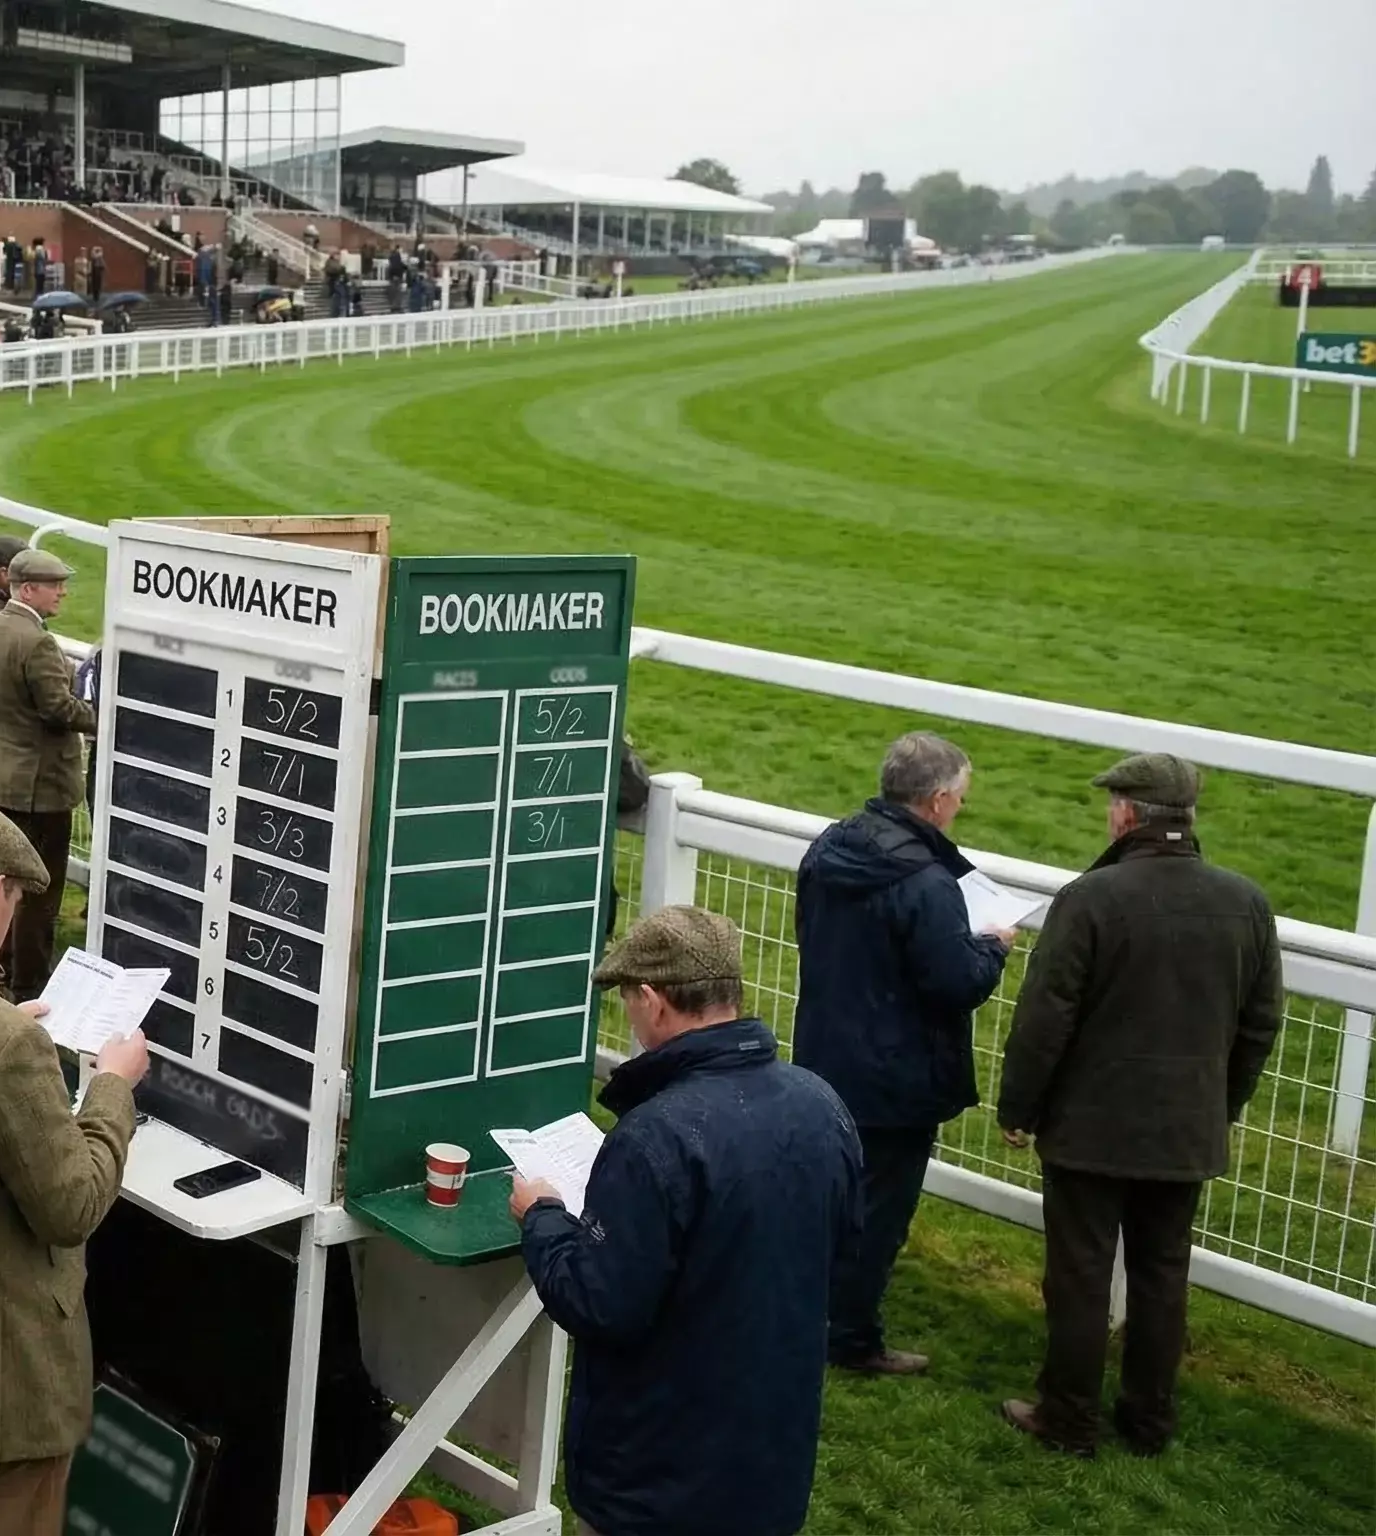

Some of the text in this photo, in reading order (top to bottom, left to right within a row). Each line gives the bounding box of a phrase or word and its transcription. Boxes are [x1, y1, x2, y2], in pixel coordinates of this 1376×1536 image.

[133, 560, 337, 628] BOOKMAKER
[419, 591, 605, 635] BOOKMAKER
[226, 688, 233, 708] 1
[265, 688, 319, 738] 5/2
[534, 697, 585, 740] 5/2
[221, 749, 231, 768] 2
[263, 750, 305, 796] 7/1
[534, 752, 573, 795] 7/1
[216, 806, 227, 826] 3
[257, 811, 305, 859] 3/3
[527, 807, 564, 845] 3/1
[212, 865, 223, 885] 4
[255, 870, 300, 920] 7/2
[209, 921, 219, 940] 5
[245, 926, 300, 979] 5/2
[204, 977, 214, 996] 6
[200, 1032, 211, 1051] 7
